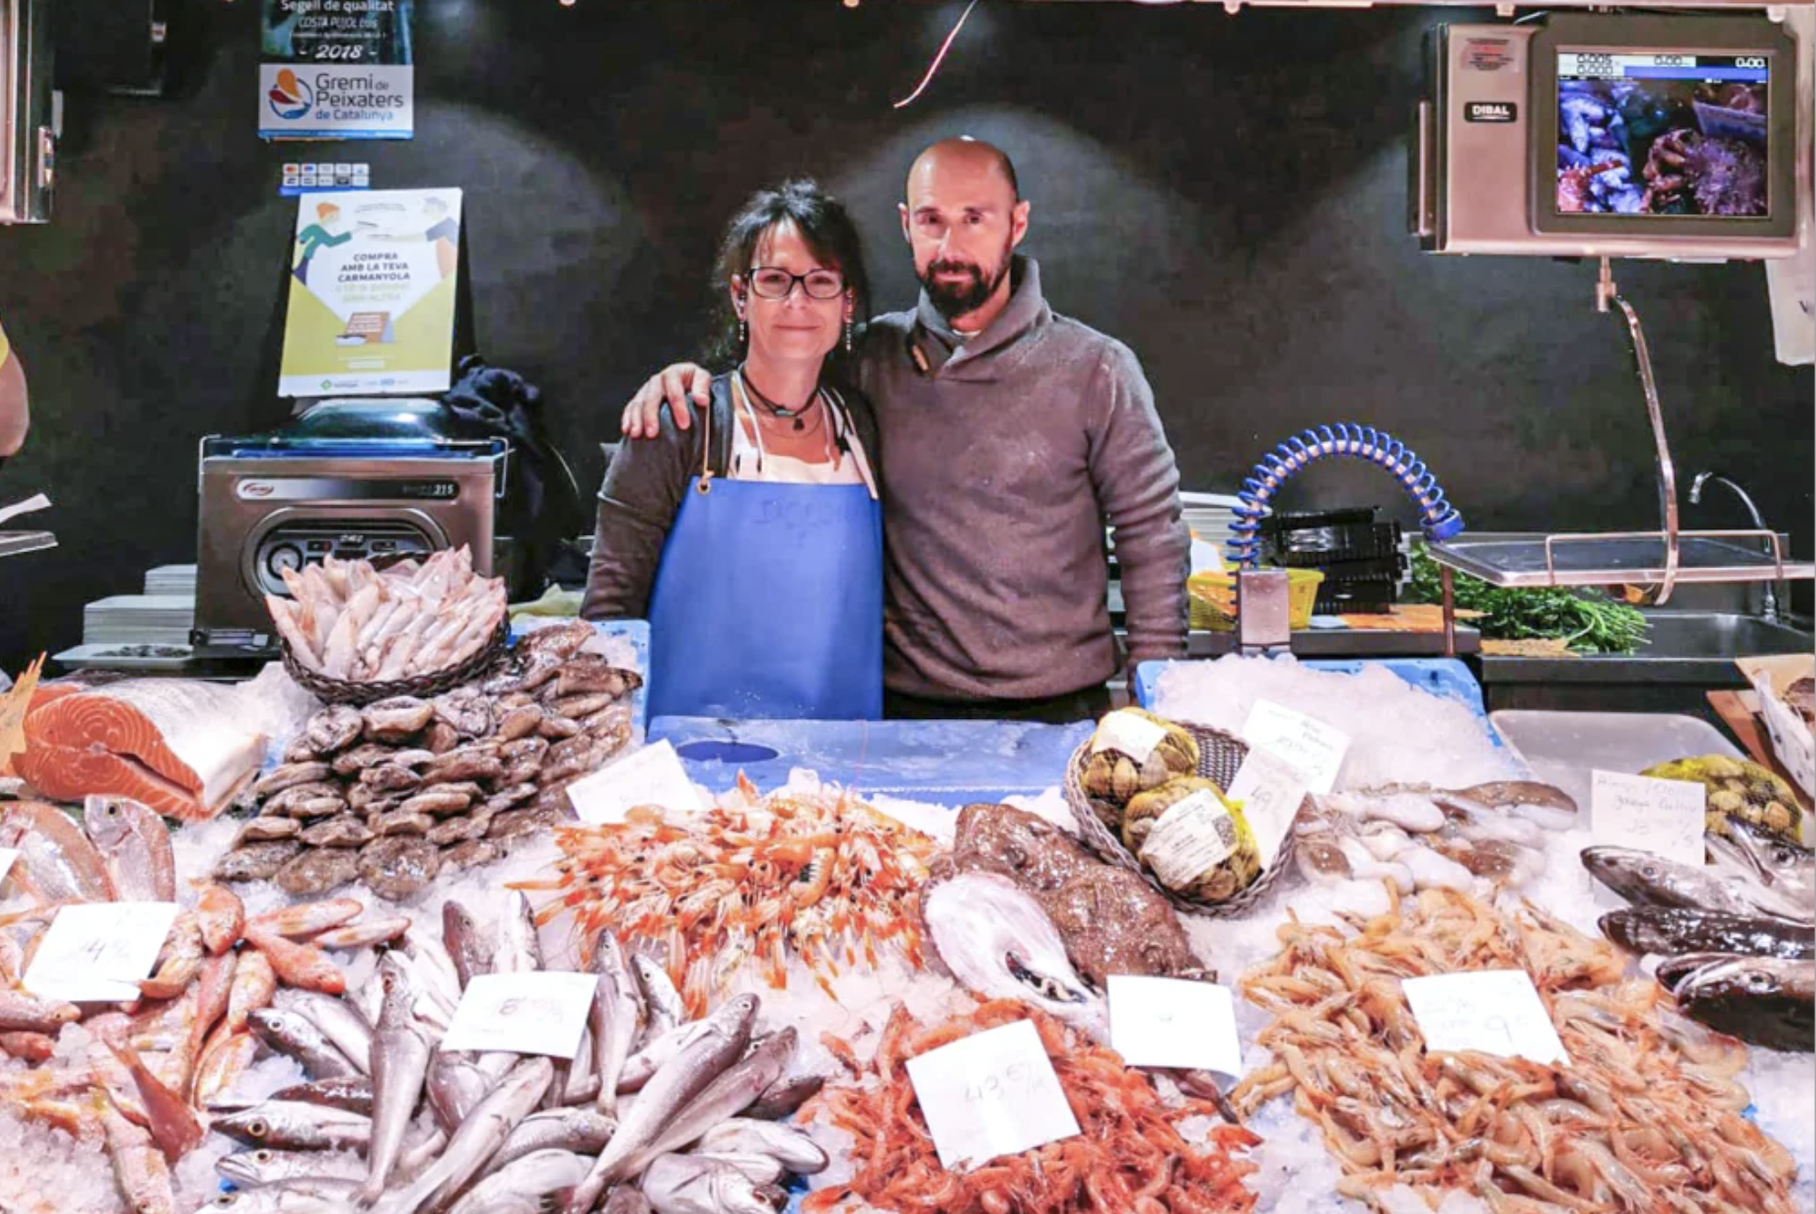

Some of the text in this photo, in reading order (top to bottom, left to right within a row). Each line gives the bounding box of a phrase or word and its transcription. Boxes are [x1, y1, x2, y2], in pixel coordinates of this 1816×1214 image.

[282, 0, 394, 14] Segell de qualitat
[299, 16, 328, 28] COSTA
[315, 44, 363, 59] 2018
[1735, 57, 1765, 68] 0.00
[316, 73, 389, 90] Gremi de
[316, 91, 404, 108] Peixaters
[316, 109, 394, 121] de Catalunya
[1472, 105, 1510, 116] DIBAL
[353, 252, 398, 261] COMPRA
[341, 262, 409, 272] AMB LA TEVA
[338, 273, 411, 283] CARMANYOLA
